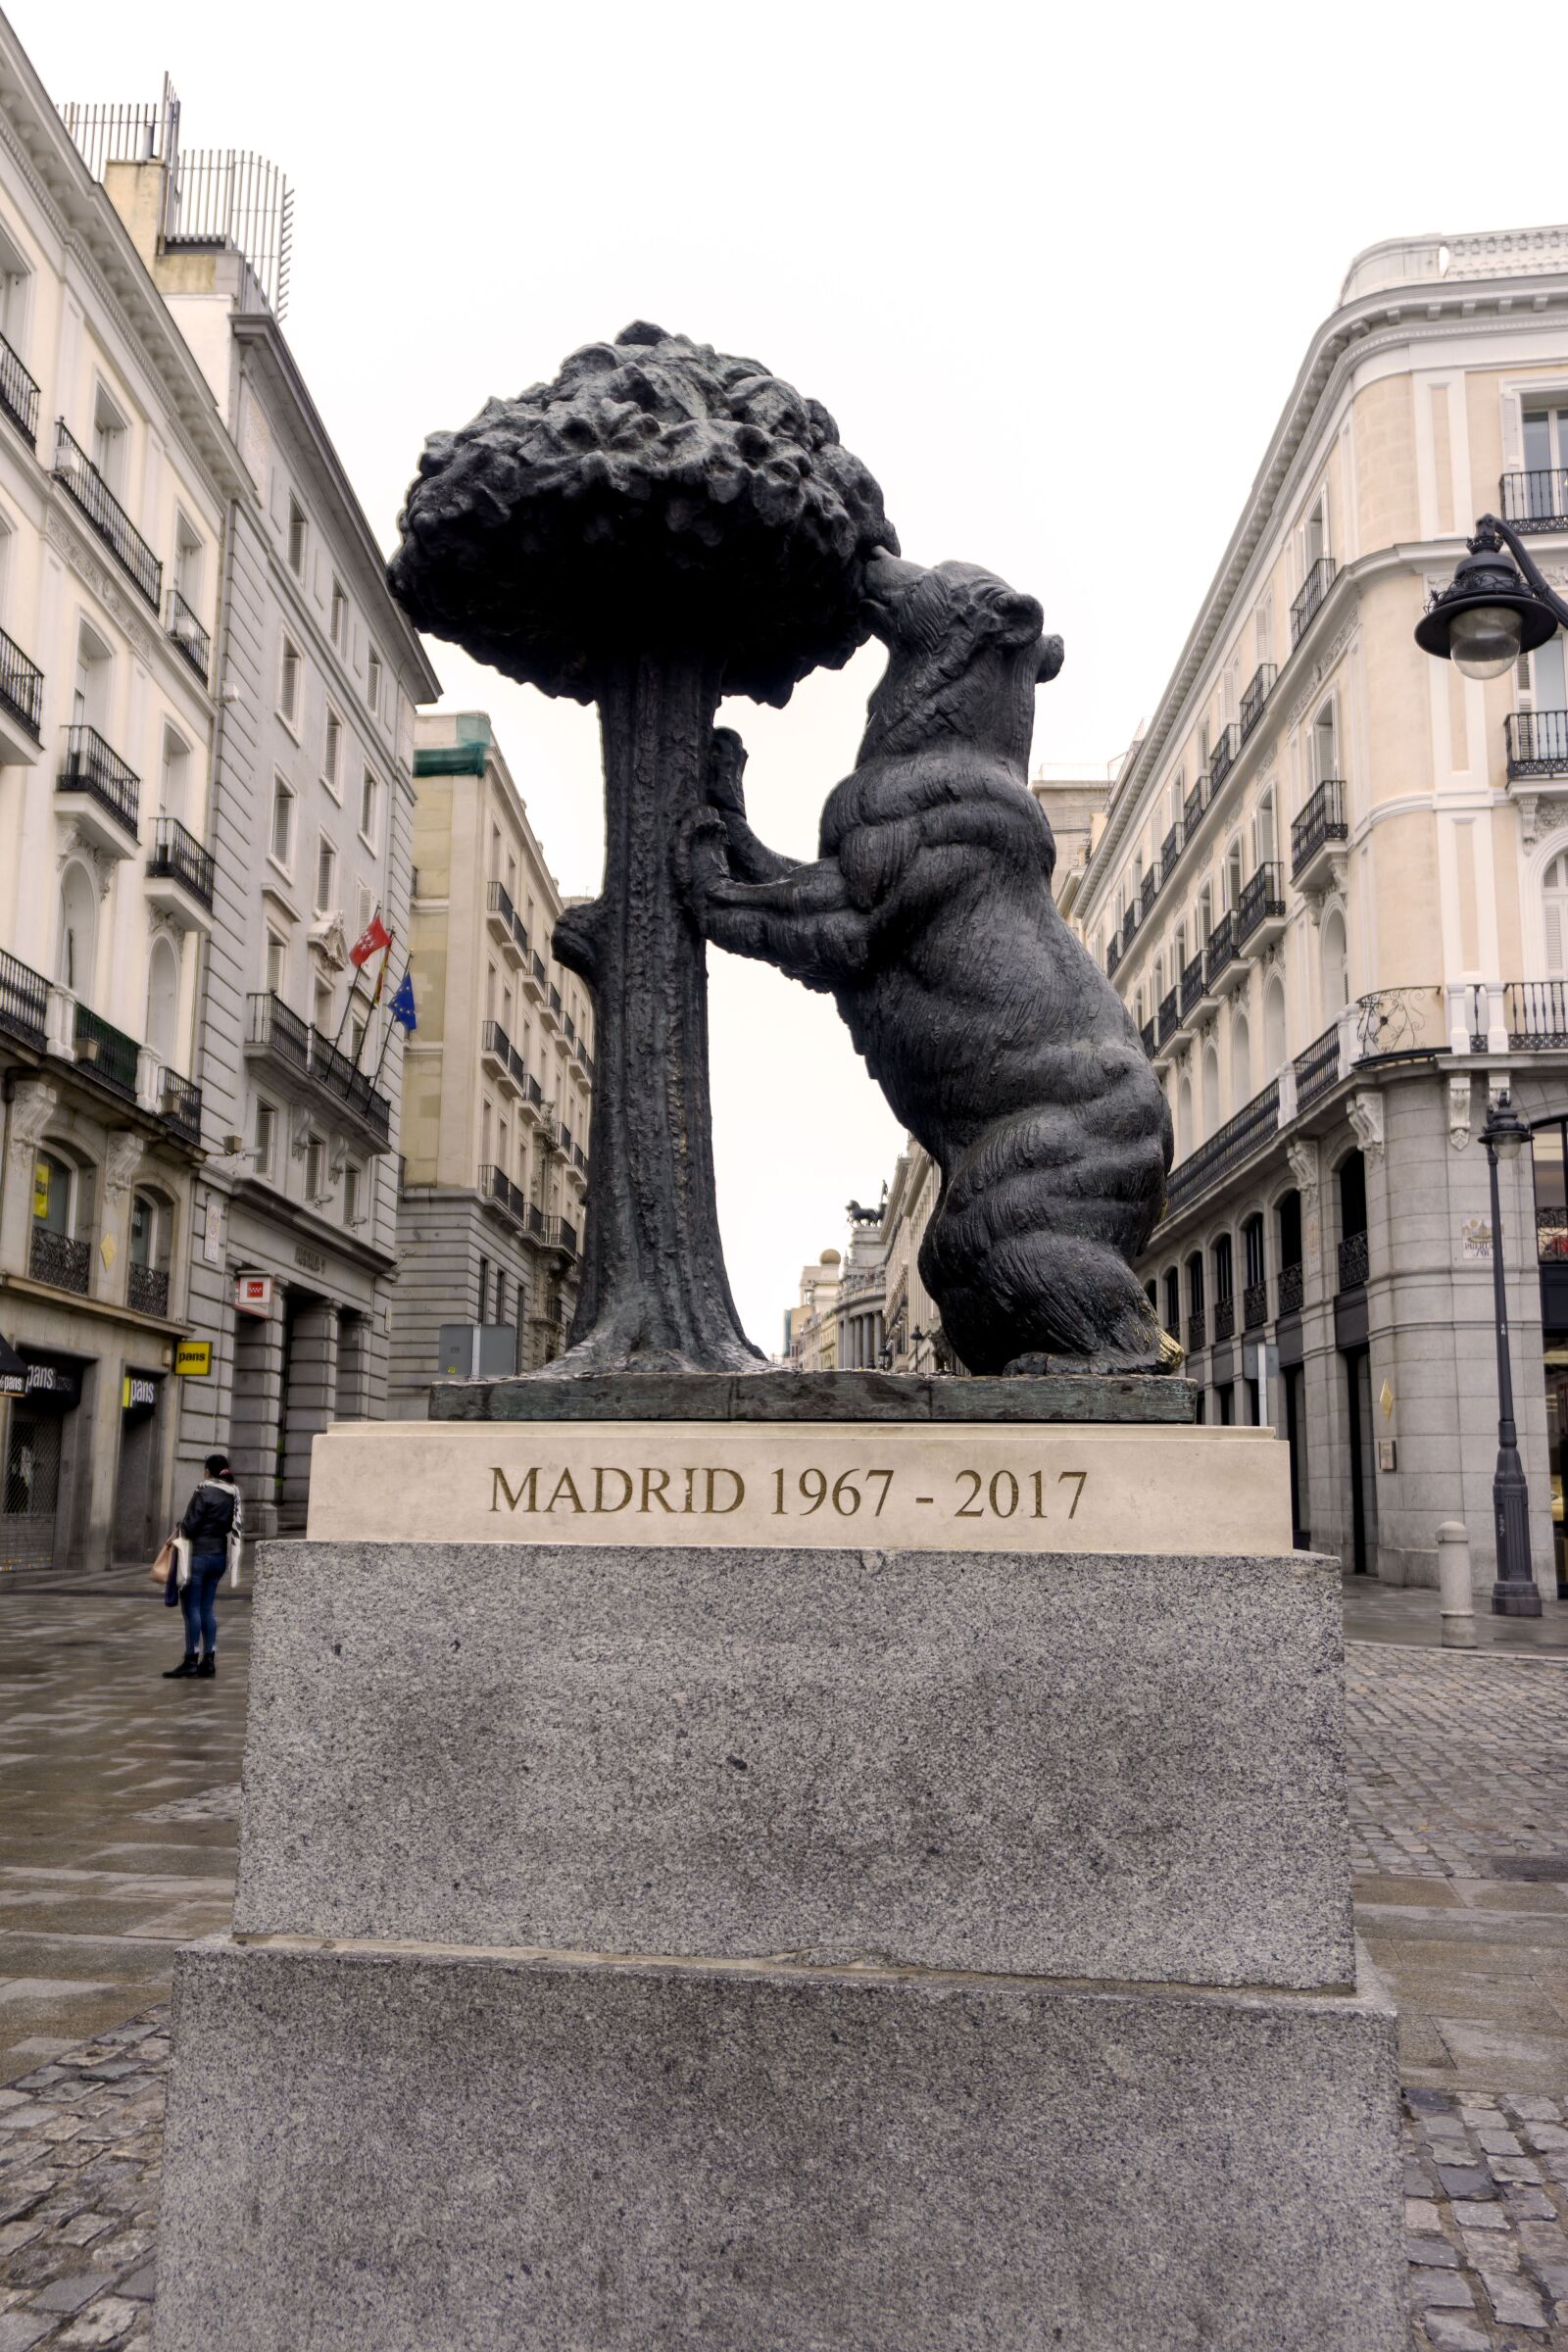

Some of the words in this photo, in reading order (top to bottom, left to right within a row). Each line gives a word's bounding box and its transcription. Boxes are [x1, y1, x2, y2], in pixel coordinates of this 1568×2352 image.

[178, 1351, 206, 1363] pans
[25, 1364, 54, 1394] pans
[129, 1379, 155, 1408] pans
[488, 1466, 745, 1513] MADRID
[771, 1468, 895, 1517] 1967
[954, 1469, 1088, 1519] 2017
